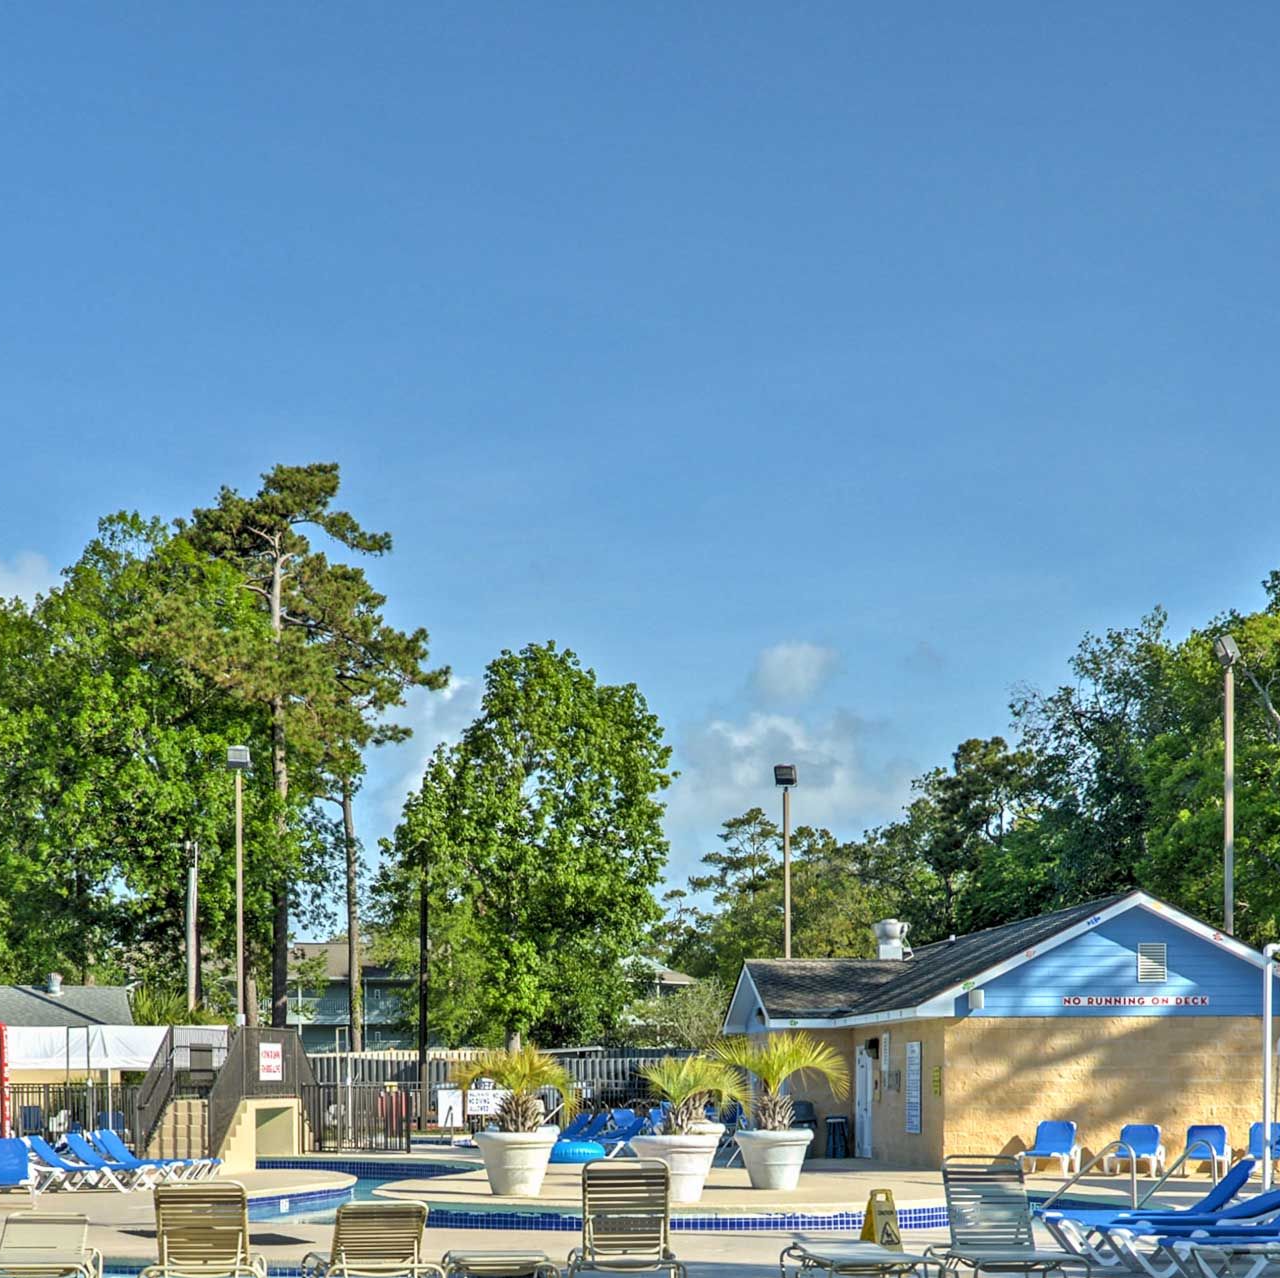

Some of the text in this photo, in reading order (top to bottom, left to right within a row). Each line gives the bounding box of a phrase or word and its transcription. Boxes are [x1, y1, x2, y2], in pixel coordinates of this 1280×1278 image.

[1063, 997, 1209, 1005] NO RUNNING ON DECK
